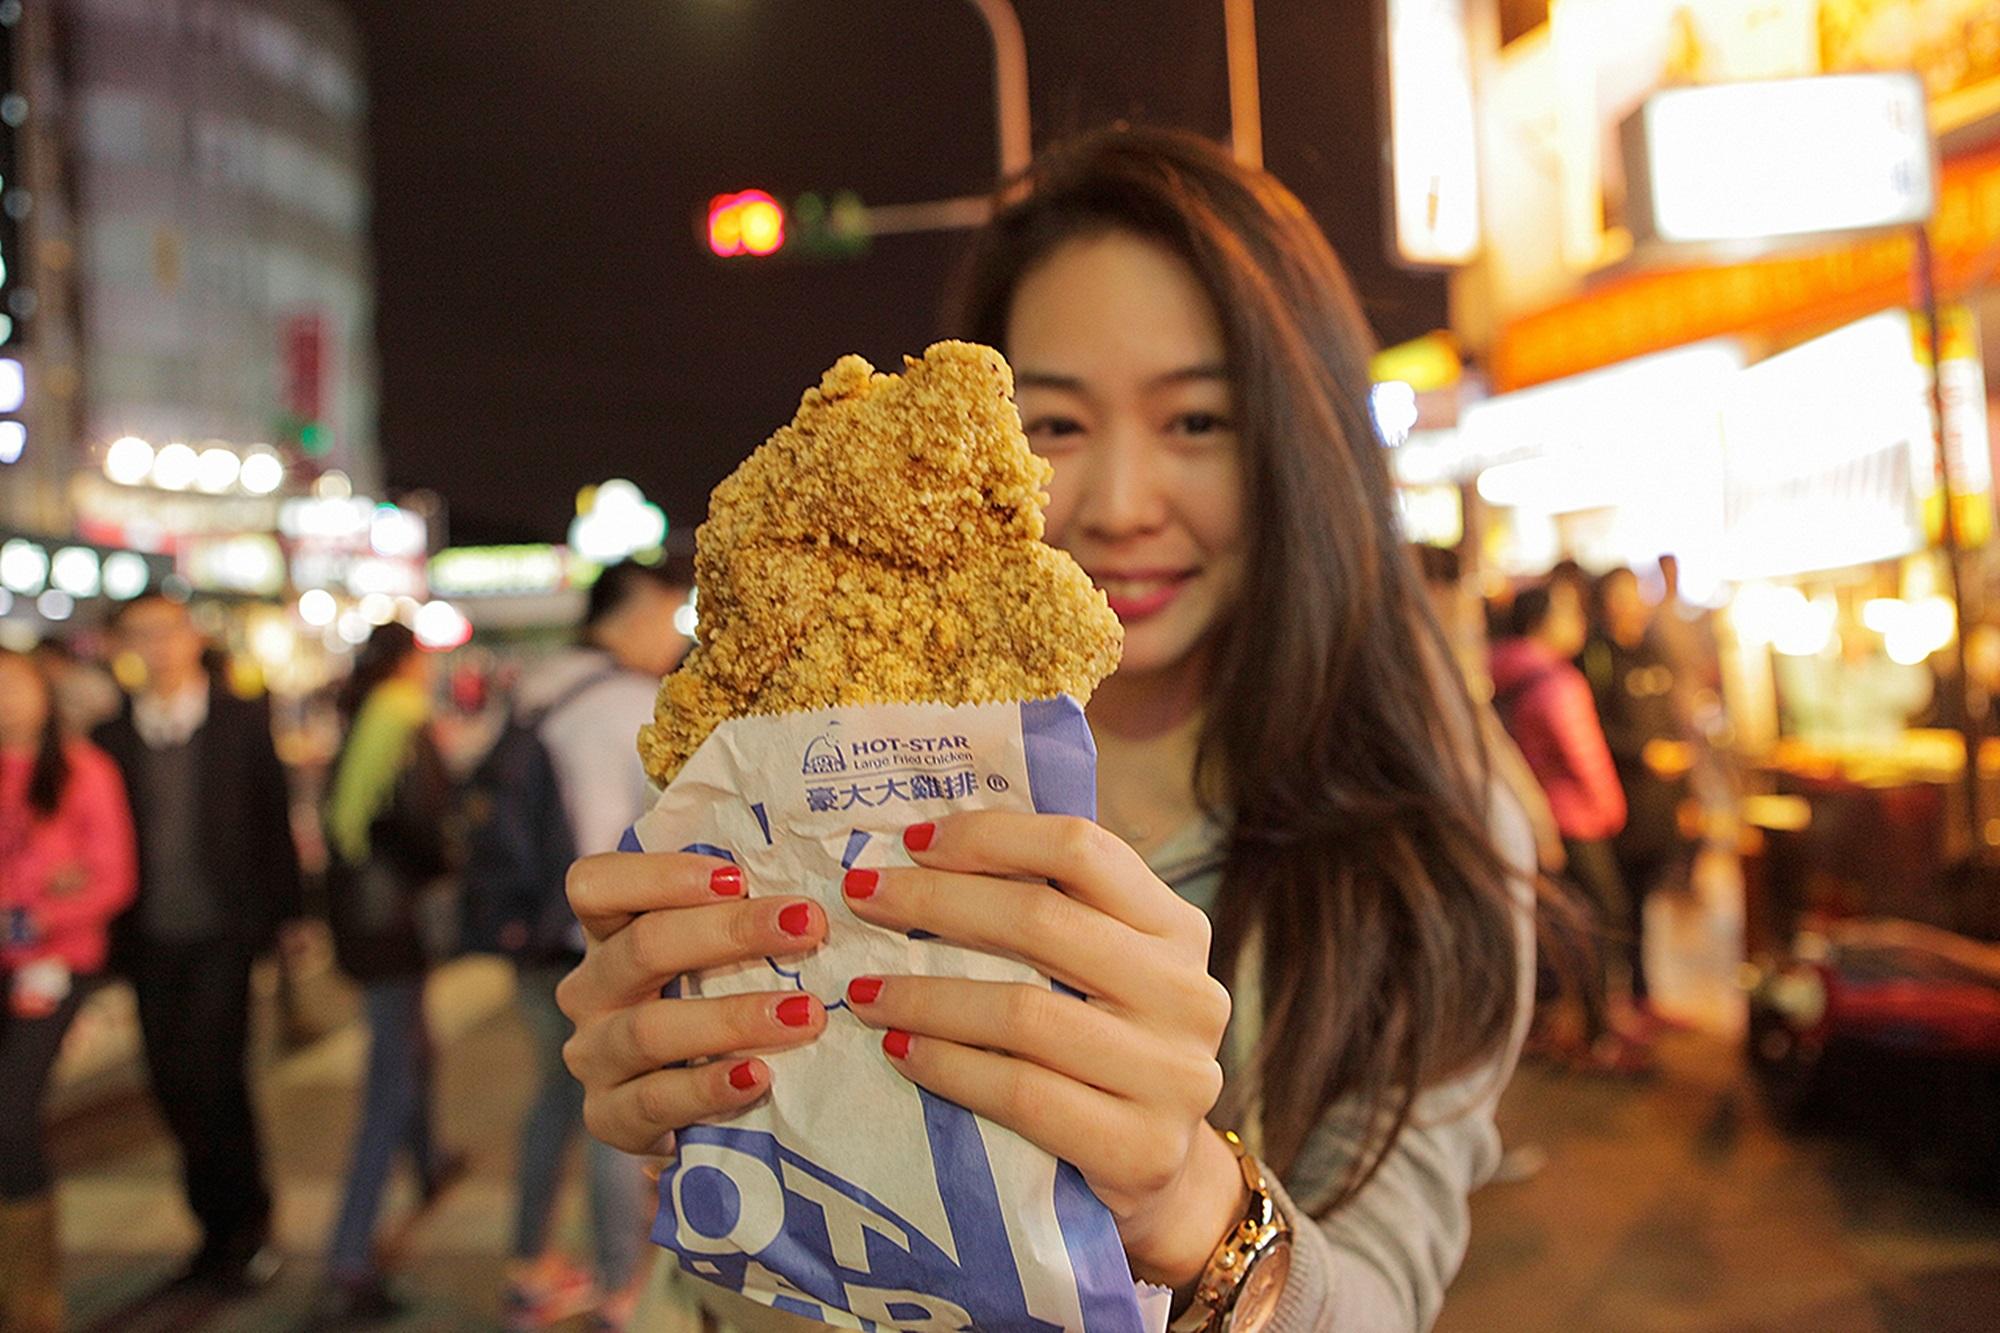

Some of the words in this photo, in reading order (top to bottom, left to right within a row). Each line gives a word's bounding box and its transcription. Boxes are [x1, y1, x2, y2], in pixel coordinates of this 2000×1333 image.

[851, 736, 971, 755] HOT-STAR
[853, 757, 889, 770] Large
[892, 753, 922, 765] Fried
[924, 750, 974, 766] Chicken
[806, 772, 979, 812] 豪大大雞排
